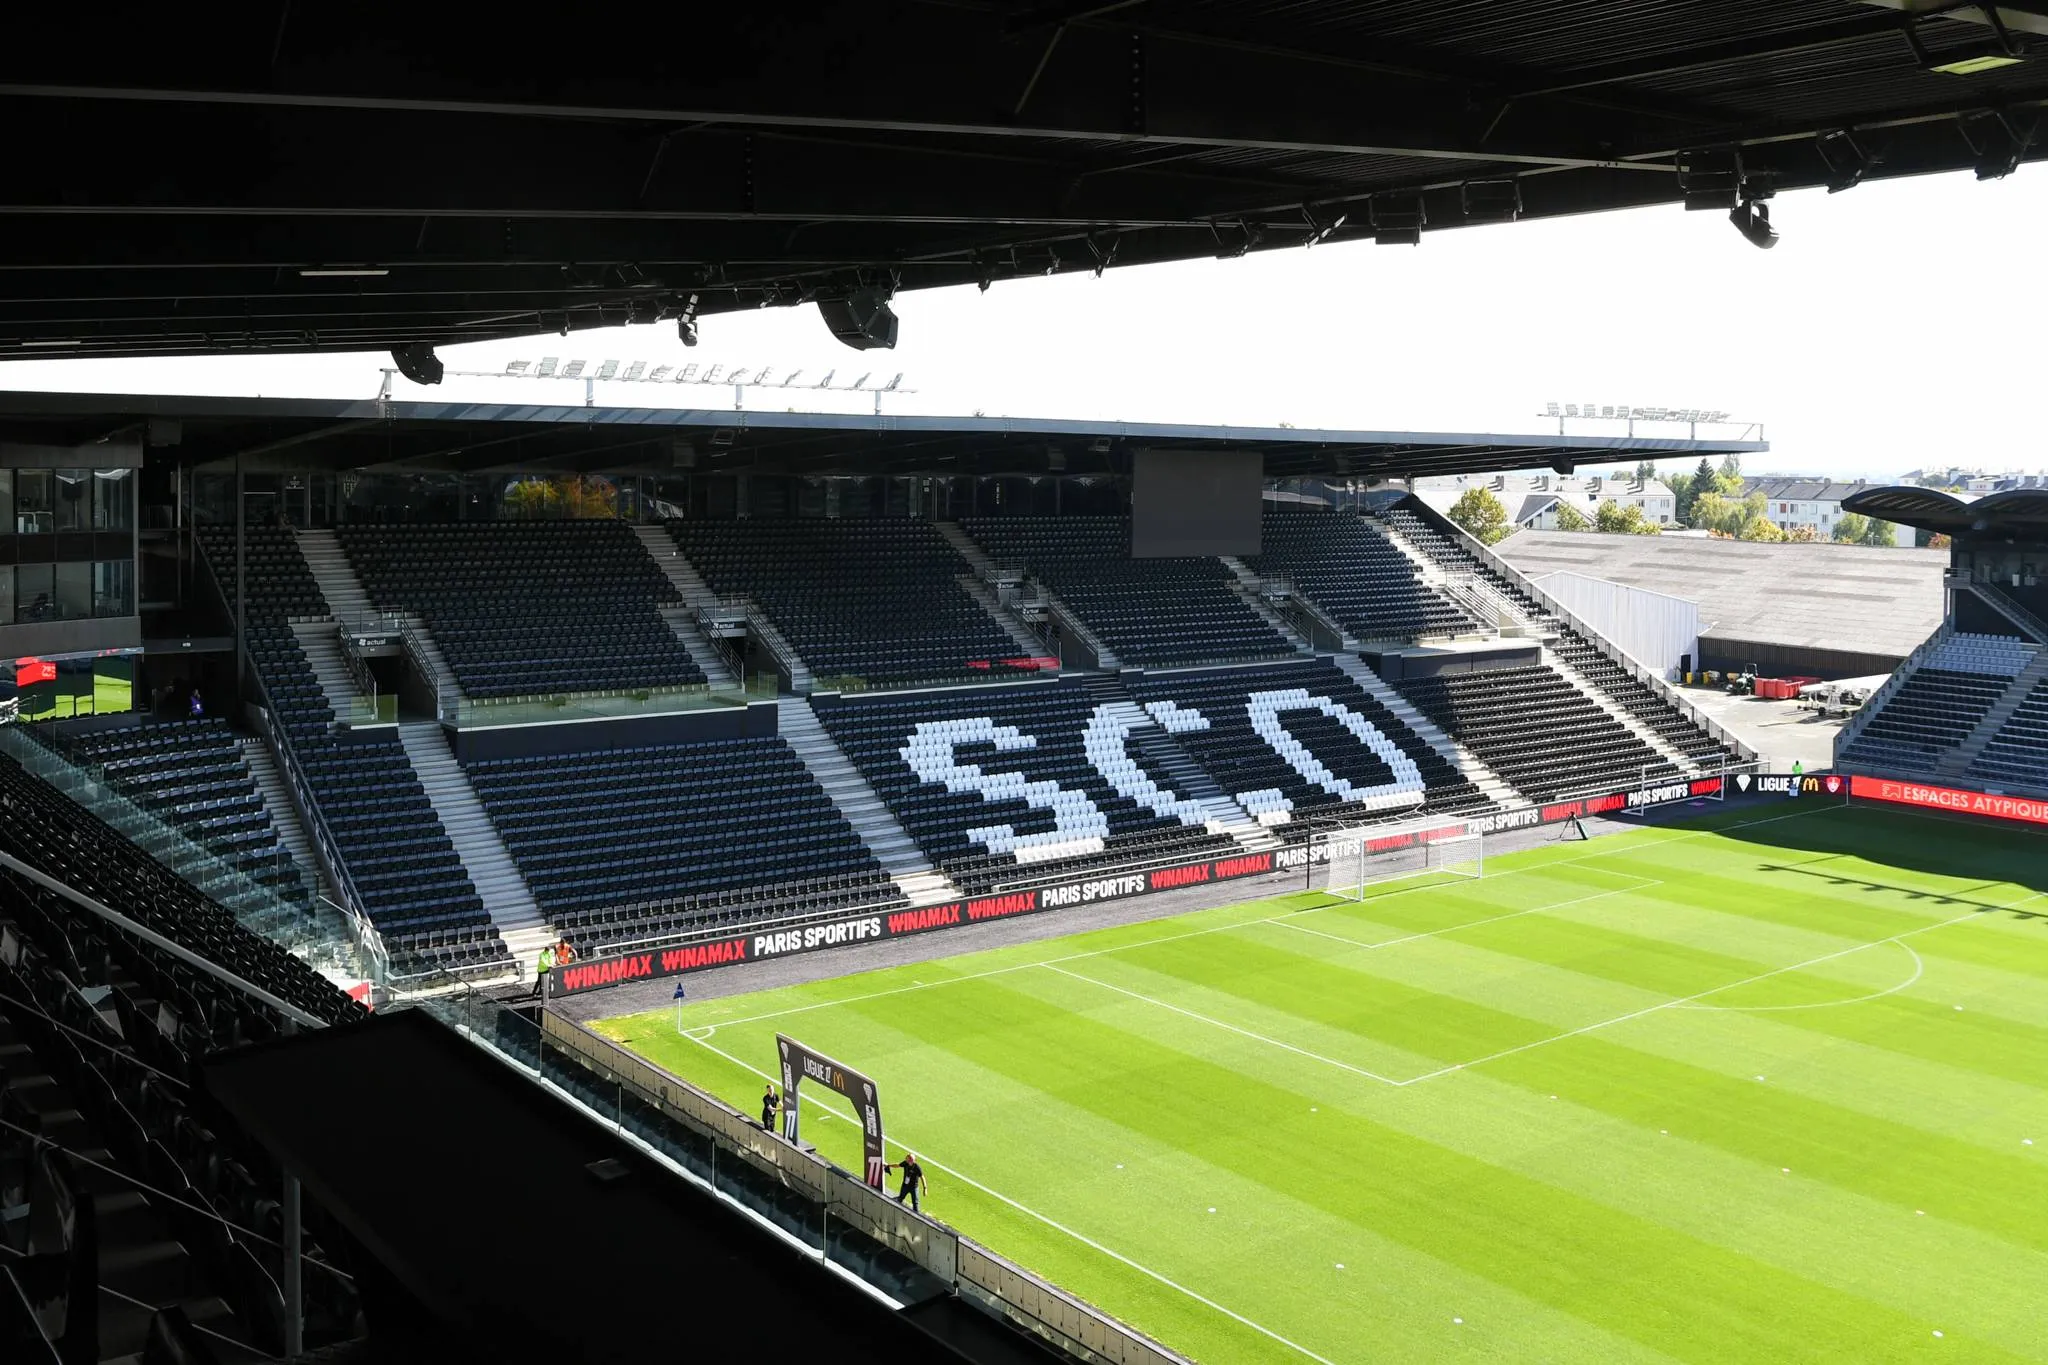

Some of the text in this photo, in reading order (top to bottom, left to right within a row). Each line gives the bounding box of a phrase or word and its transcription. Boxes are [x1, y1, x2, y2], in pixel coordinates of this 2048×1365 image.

[366, 638, 387, 646] actual
[898, 687, 1427, 864] SCO
[1757, 777, 1790, 792] LIGUE
[1903, 786, 1969, 808] ESPACES
[563, 954, 653, 991] WINAMAX
[661, 939, 748, 972] WINAMAX
[754, 931, 802, 956] PARIS
[804, 917, 881, 948] SPORTIFS
[888, 904, 961, 933] WINAMAX
[967, 892, 1036, 920] WINAMAX
[1042, 884, 1081, 908] PARIS
[1082, 874, 1145, 900] SPORTIFS
[1150, 863, 1209, 888] WINAMAX
[1215, 853, 1271, 878] WINAMAX
[1276, 846, 1308, 868] PARIS
[1309, 839, 1361, 861] SPORTIFS
[1495, 808, 1538, 830] SPORTIFS
[1542, 801, 1583, 821] WINAMAX
[1587, 793, 1625, 813] WINAMAX
[1651, 783, 1688, 801] SPORTIFS
[803, 1055, 825, 1081] LIGUE
